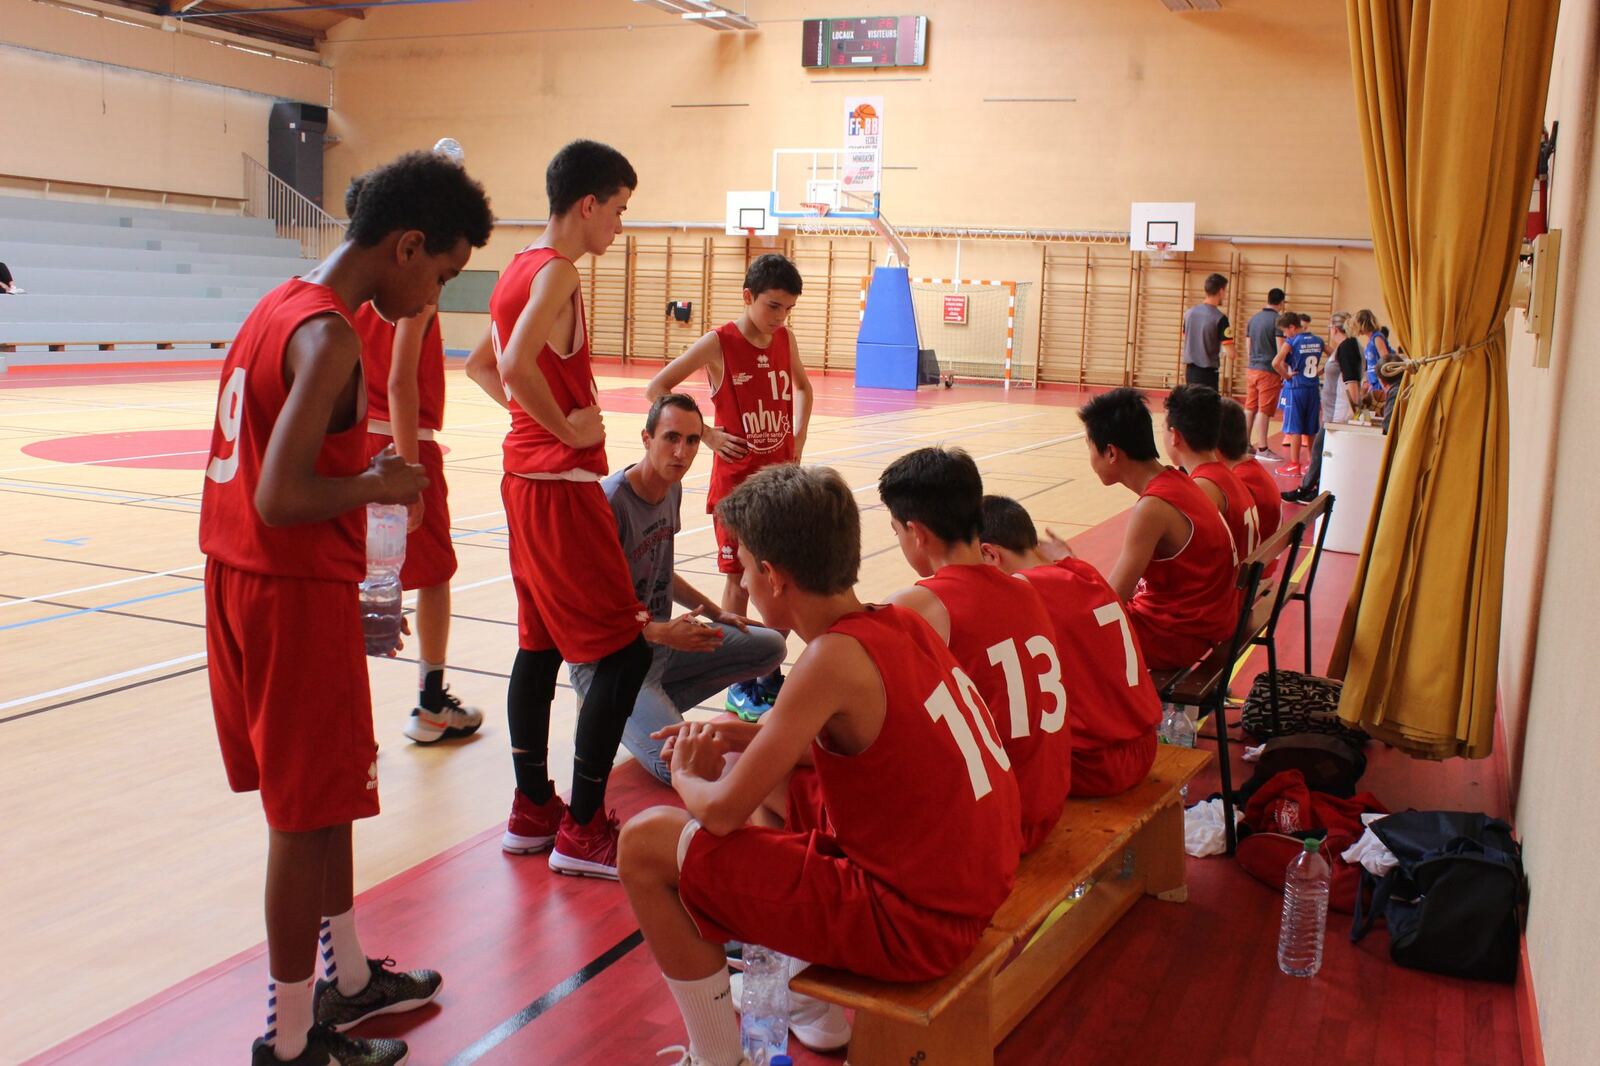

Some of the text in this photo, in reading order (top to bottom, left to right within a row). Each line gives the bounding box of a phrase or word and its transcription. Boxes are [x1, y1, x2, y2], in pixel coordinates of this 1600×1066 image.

[832, 30, 897, 40] LOCAUX VISITEURS
[768, 370, 791, 401] 12
[1303, 355, 1318, 378] 8
[206, 366, 246, 484] 9
[742, 399, 782, 434] mhv
[1093, 601, 1139, 688] 7
[986, 635, 1067, 739] 13
[923, 666, 1011, 802] 10
